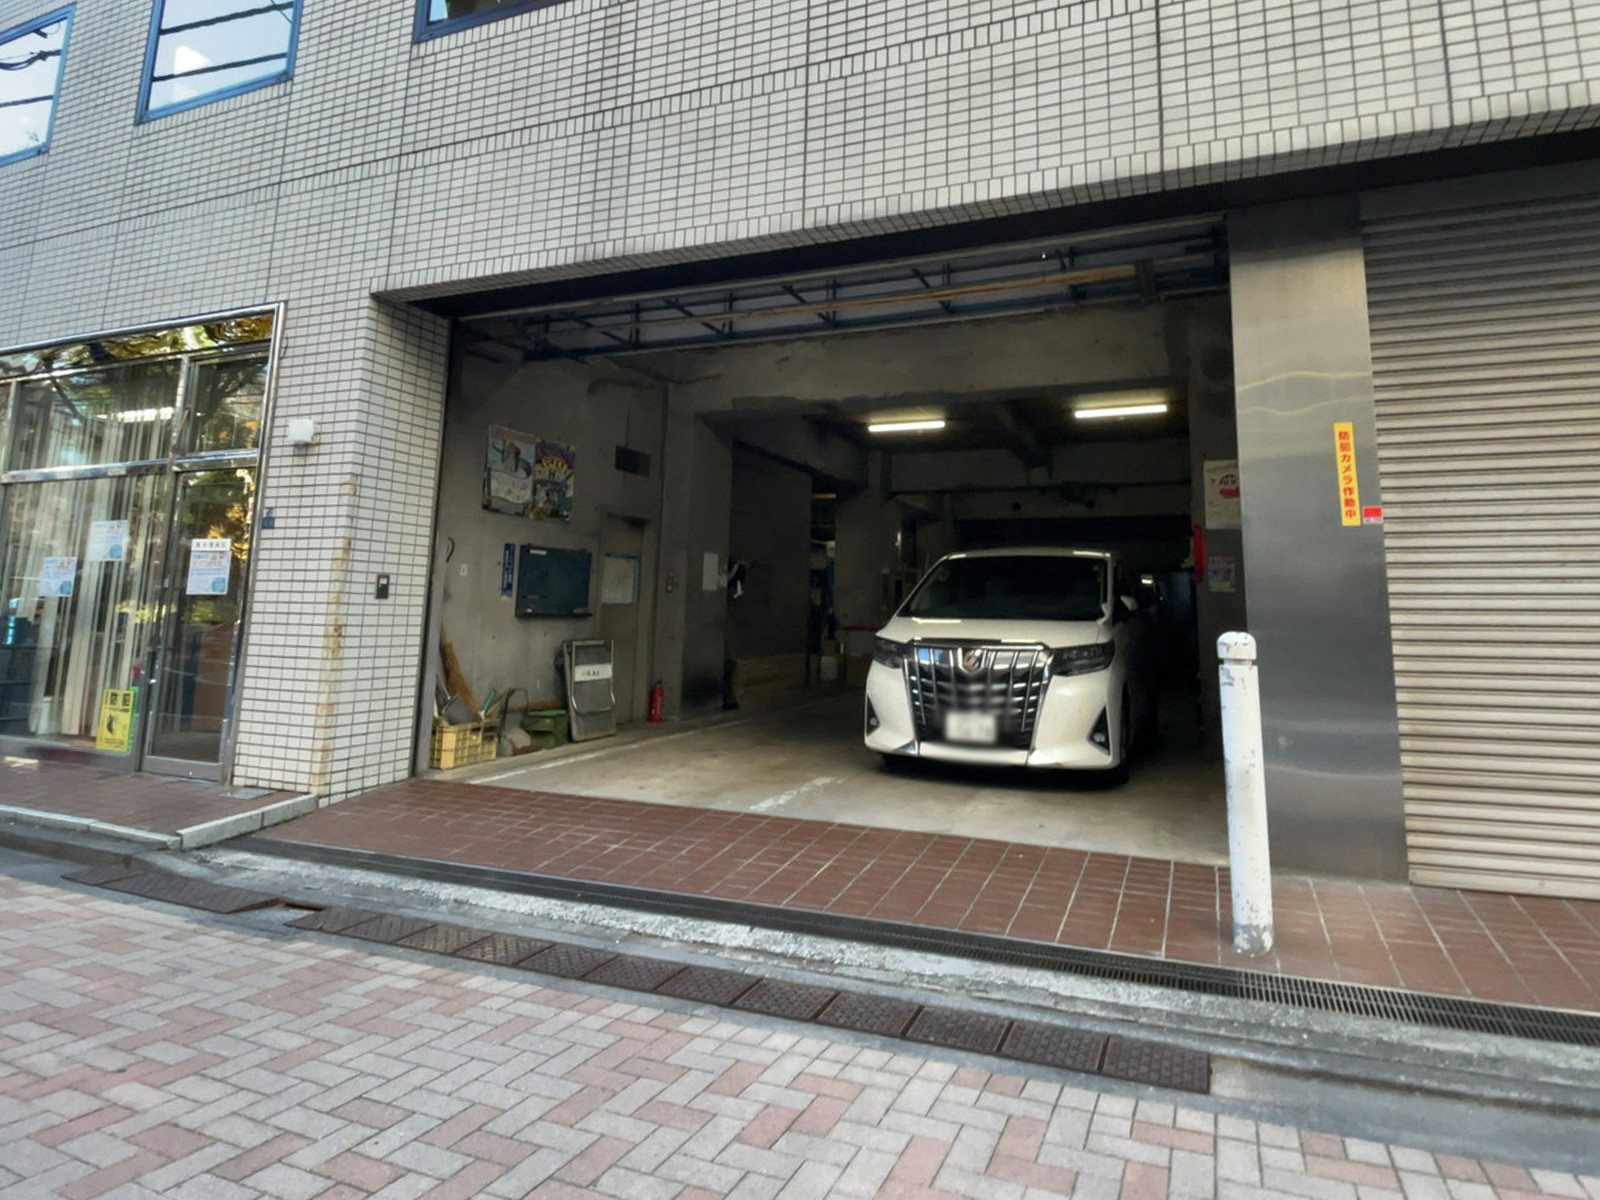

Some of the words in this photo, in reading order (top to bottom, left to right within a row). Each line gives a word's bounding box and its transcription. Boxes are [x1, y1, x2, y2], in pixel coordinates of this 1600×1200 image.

[1338, 431, 1357, 519] 防犯カメラ作動中
